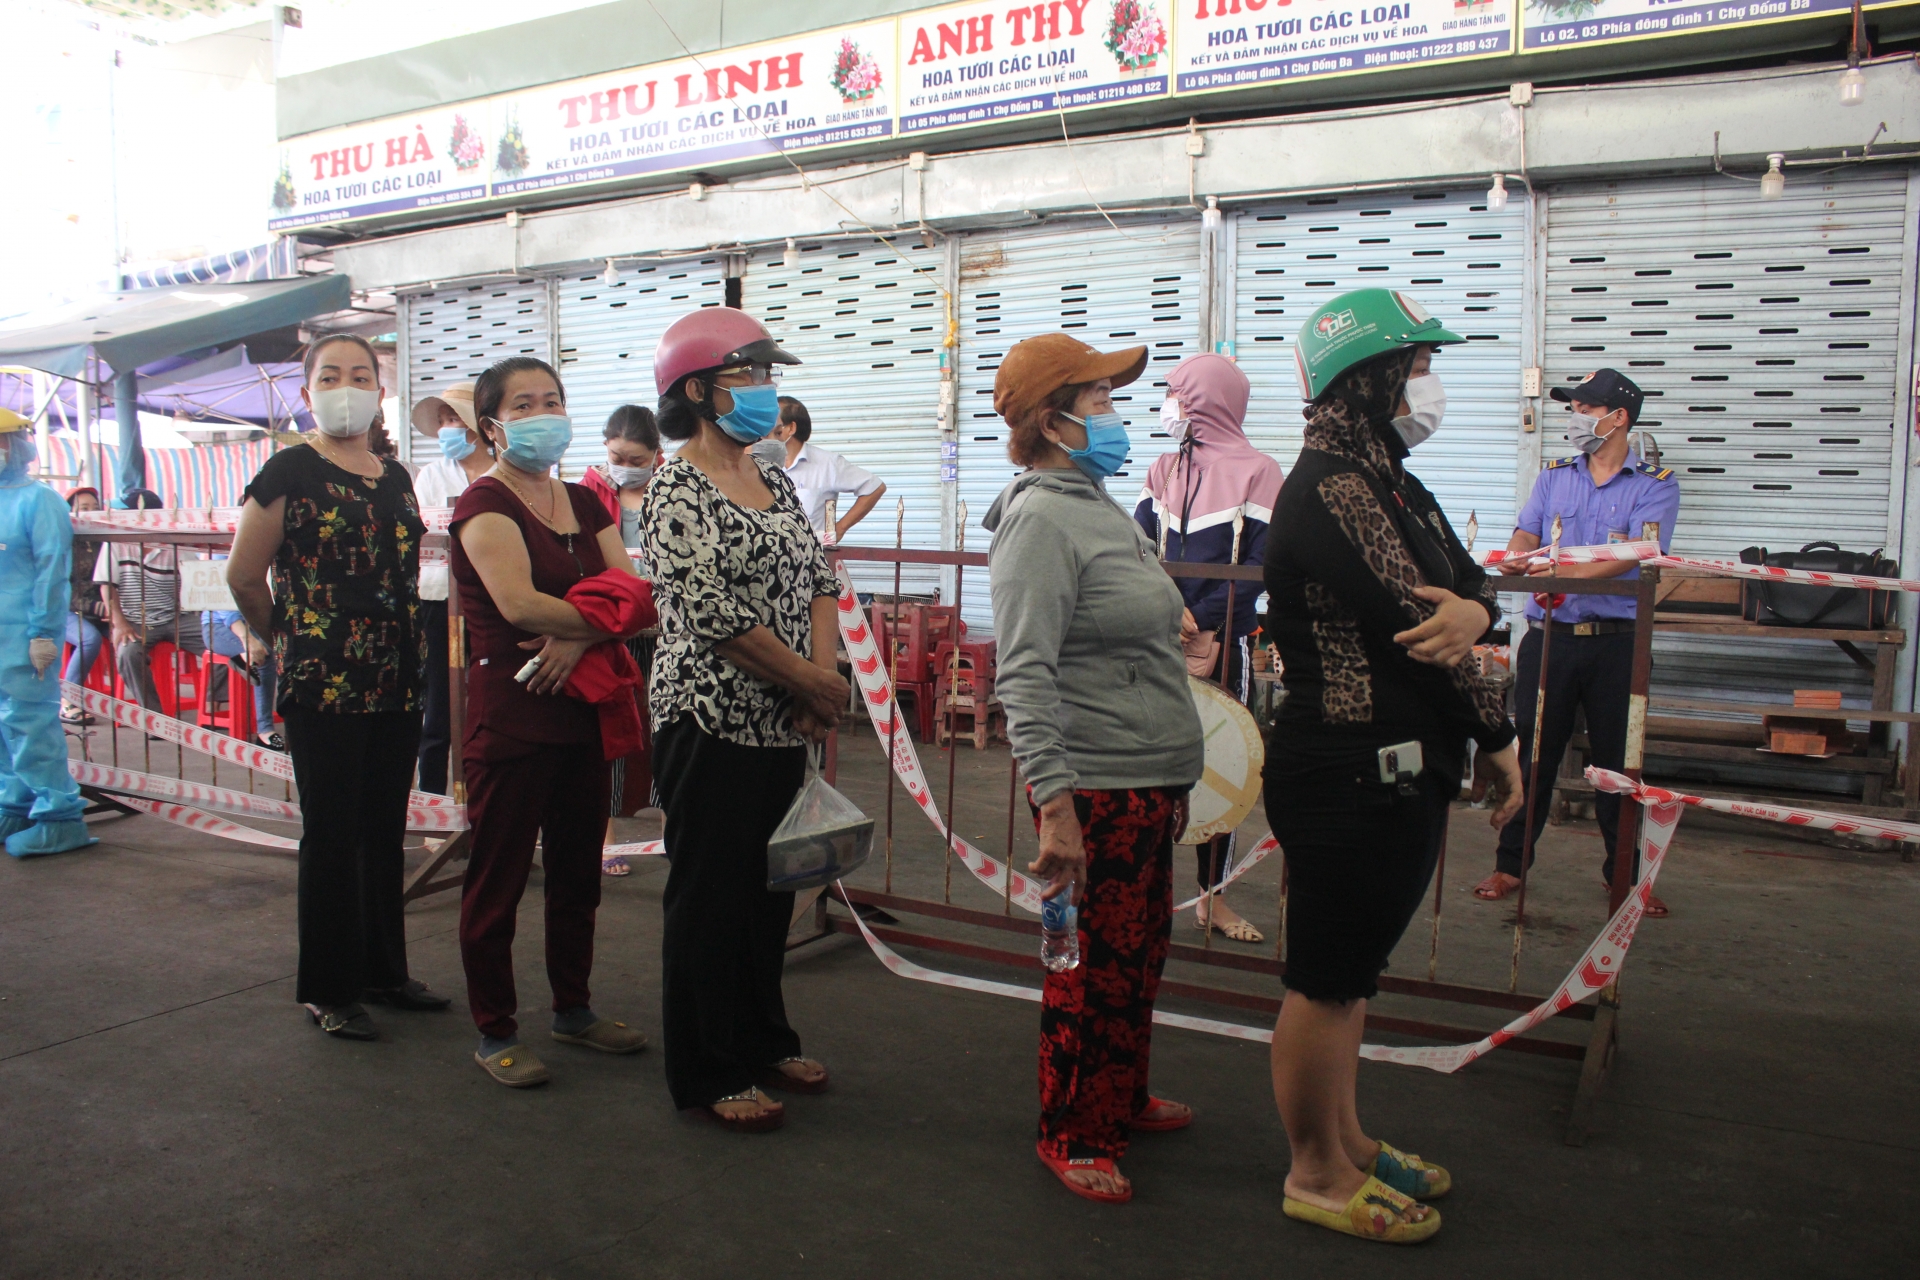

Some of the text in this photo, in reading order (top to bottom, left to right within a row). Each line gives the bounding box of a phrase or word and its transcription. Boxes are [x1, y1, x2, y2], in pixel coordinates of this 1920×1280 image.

[908, 0, 1090, 65] ANH THY
[1208, 3, 1410, 47] HOA TƯƠI CÁC LOẠI
[1442, 13, 1506, 30] GIAO HÀNG TẬN NƠI
[1540, 0, 1809, 43] Lô 02, 03 Phía đông đình 1 Chợ Đống Đa
[1191, 53, 1212, 65] KẾT
[1215, 51, 1230, 62] VÀ
[1233, 47, 1260, 59] ĐẢM
[1264, 43, 1297, 55] NHẬN
[1301, 38, 1325, 50] CÁC
[1330, 34, 1358, 47] DỊCH
[1363, 31, 1379, 43] VỤ
[1402, 25, 1428, 36] HOA
[1364, 37, 1498, 64] Điện thoại: 01222 889 437
[922, 48, 1075, 88] HOA TƯƠI CÁC LOẠI
[1185, 57, 1353, 88] Lô 04 Phía đông đình 1 Chợ Đống Đa
[558, 52, 804, 128] THU LINH
[910, 97, 925, 107] KẾT
[928, 93, 939, 104] VÀ
[942, 88, 962, 101] ĐẢM
[965, 85, 990, 98] NHẬN
[993, 82, 1012, 93] CÁC
[1014, 79, 1036, 91] DỊCH
[1039, 75, 1051, 87] VỤ
[1069, 69, 1088, 81] HOA
[1073, 91, 1097, 104] thoại:
[1098, 86, 1125, 99] 01219
[1126, 84, 1143, 95] 480
[1144, 81, 1162, 92] 622
[569, 99, 788, 152] HOA TƯƠI CÁC LOẠI
[825, 105, 888, 124] GIAO HÀNG TẬN NƠI
[907, 100, 1043, 129] Lô 05 Phía đông đình 1 Chợ Đống Đa
[310, 124, 434, 180] THU HÀ
[546, 157, 568, 170] KẾT
[573, 153, 588, 166] VÀ
[593, 149, 622, 163] ĐẢM
[626, 142, 664, 157] NHẬN
[669, 136, 697, 150] CÁC
[702, 129, 734, 145] DỊCH
[740, 126, 757, 137] VỤ
[786, 117, 816, 130] HOA
[783, 124, 882, 148] Điện thoại: 01215 633 202
[304, 169, 441, 206] HOA TƯƠI CÁC LOẠI
